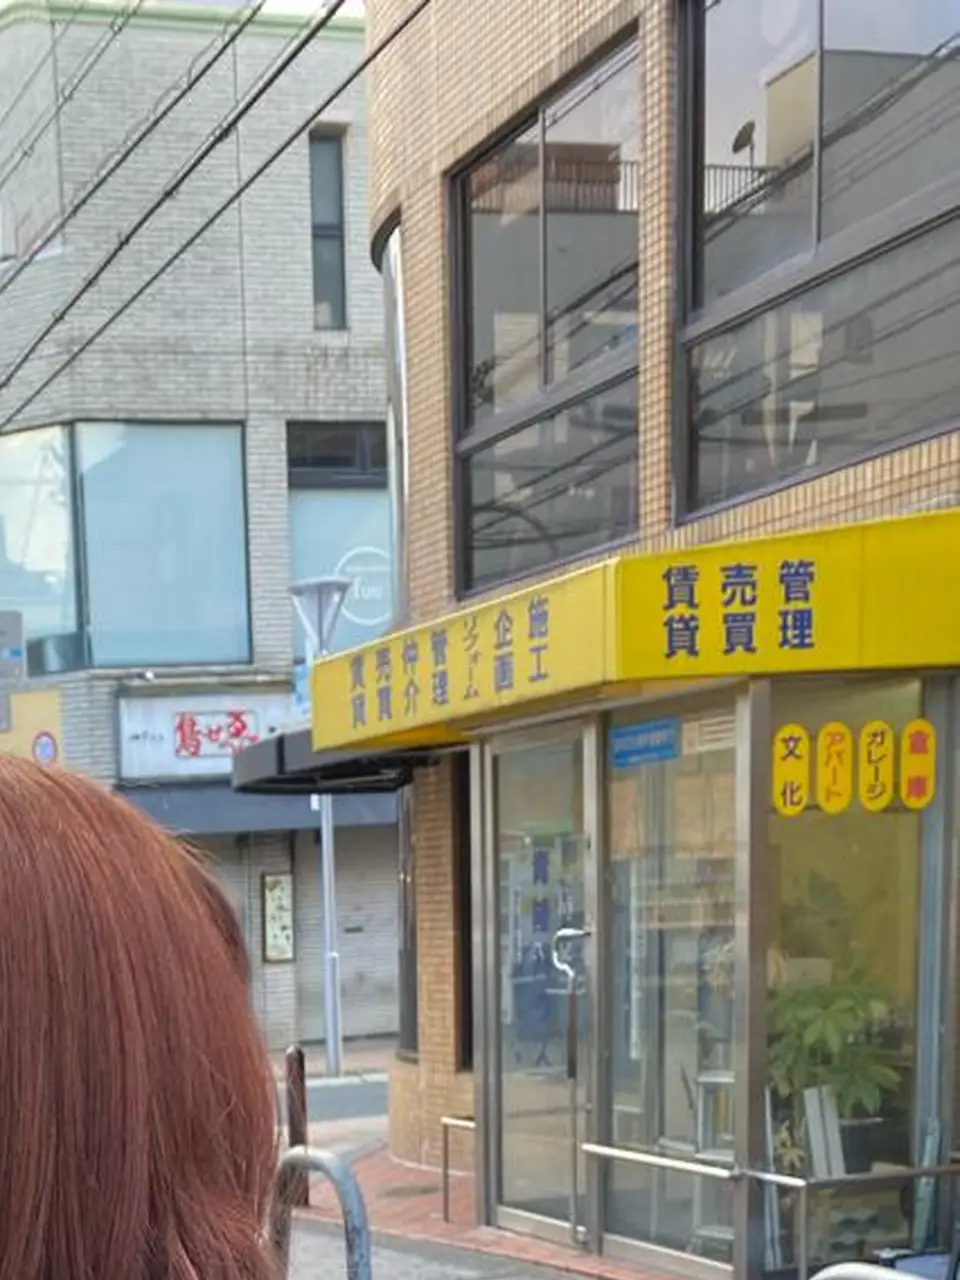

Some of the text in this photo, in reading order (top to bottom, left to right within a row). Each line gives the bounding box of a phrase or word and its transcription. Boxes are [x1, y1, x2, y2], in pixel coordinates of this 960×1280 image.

[528, 596, 550, 682] 施工
[662, 564, 700, 659] 賃貸
[720, 562, 758, 655] 売買
[778, 559, 816, 649] 管理
[402, 638, 420, 717] 仲介
[430, 628, 449, 706] 管理
[494, 608, 514, 693] 企画
[780, 736, 803, 808] 文化
[825, 731, 845, 804] アパート
[867, 728, 887, 801] ガレージ
